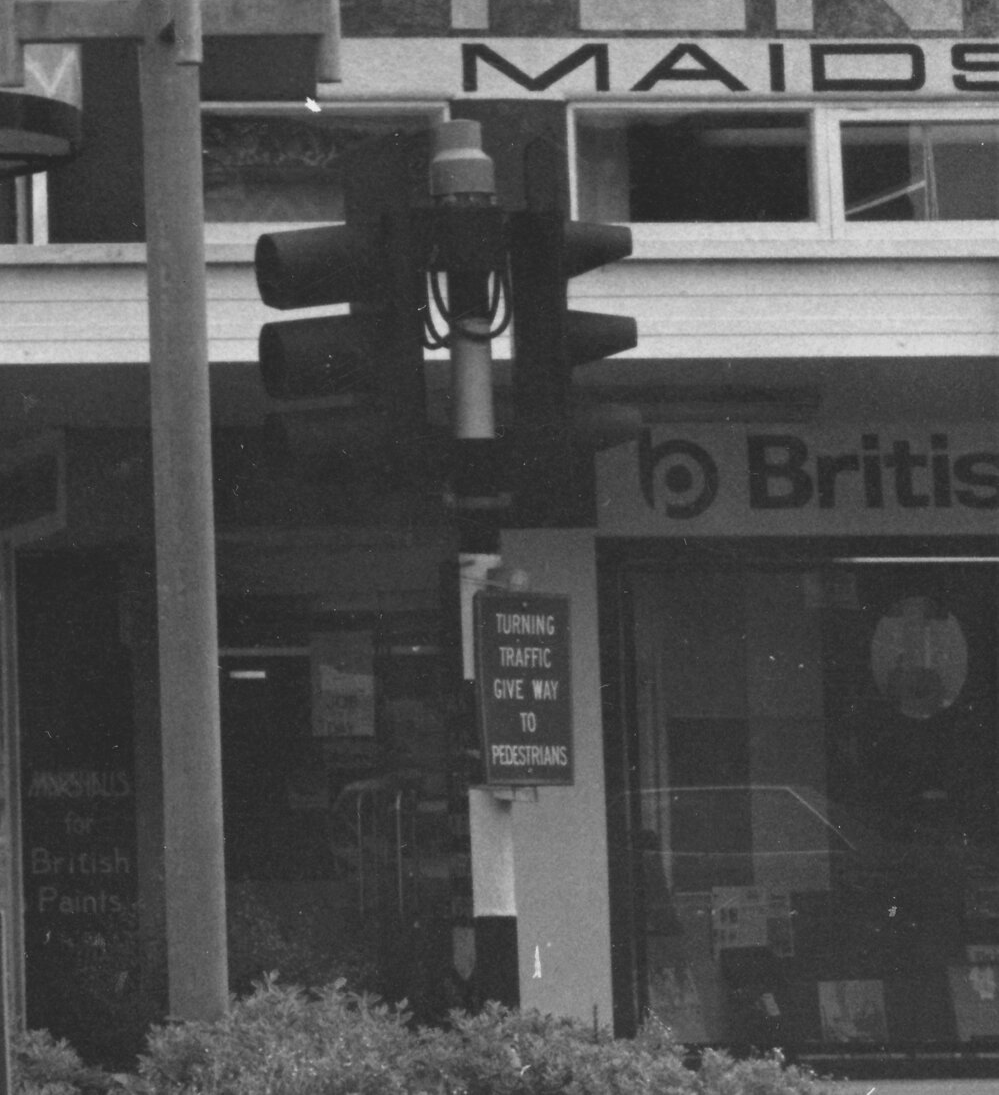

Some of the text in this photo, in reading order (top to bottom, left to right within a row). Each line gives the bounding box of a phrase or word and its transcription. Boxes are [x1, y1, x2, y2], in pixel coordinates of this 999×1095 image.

[496, 613, 555, 636] TURNING
[499, 646, 552, 668] TRAFFIC
[494, 678, 559, 701] GIVE WAY
[520, 711, 537, 733] TO
[491, 744, 568, 766] PEDESTRIANS
[64, 810, 94, 835] for
[31, 847, 131, 875] British
[38, 886, 122, 915] Paints
